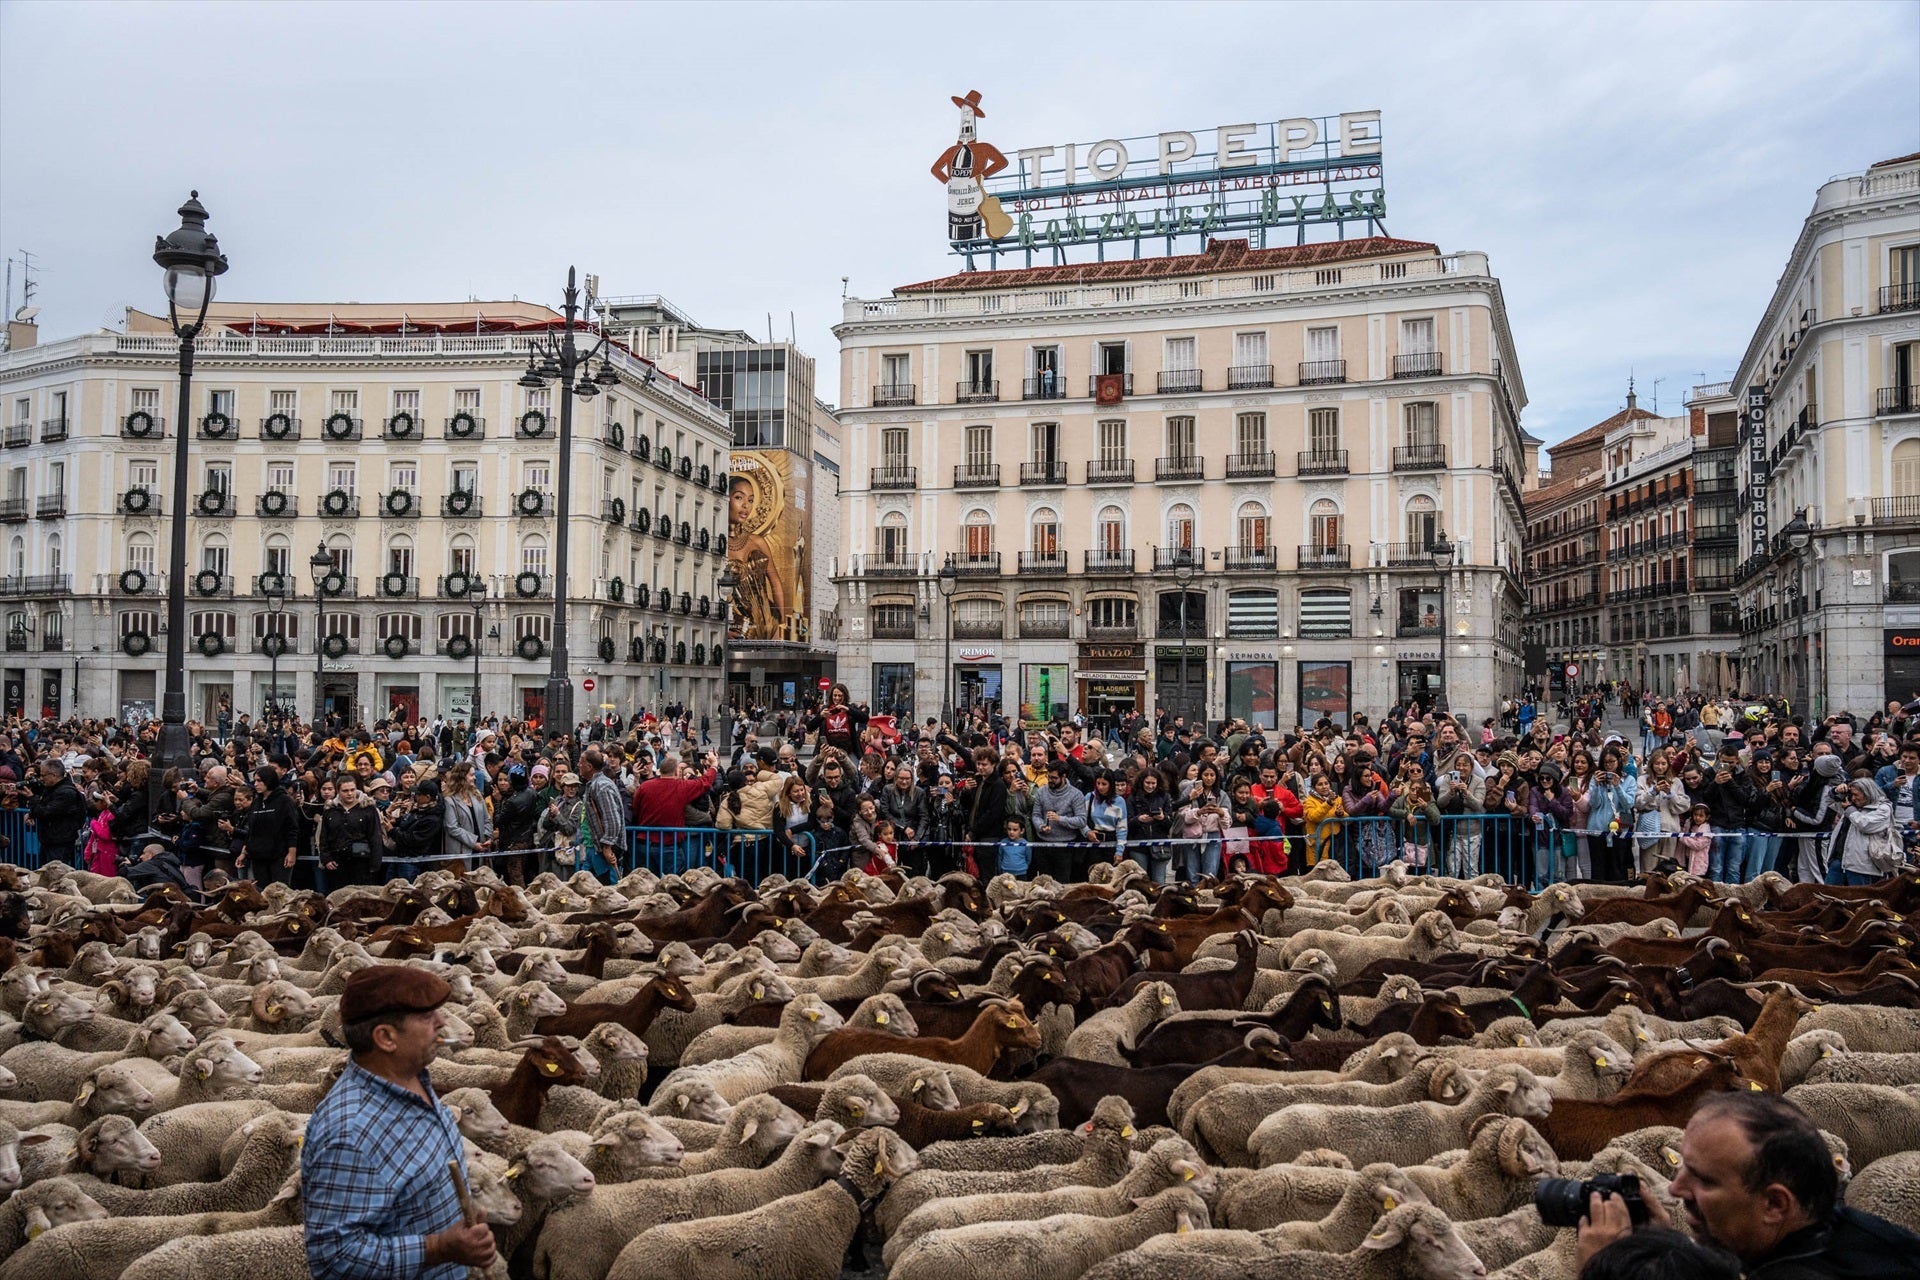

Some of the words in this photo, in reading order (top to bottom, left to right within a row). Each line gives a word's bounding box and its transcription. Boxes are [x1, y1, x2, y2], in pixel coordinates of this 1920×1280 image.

[1018, 139, 1128, 188] TIO
[1158, 109, 1382, 175] PEPE
[1014, 199, 1053, 213] SOL
[1061, 193, 1086, 208] DE
[1095, 180, 1210, 205] ANDALUCIA
[1219, 165, 1381, 192] EMBOTELLADO
[1018, 203, 1221, 246] GONZALEZ
[1261, 187, 1386, 225] BYASS
[1749, 394, 1765, 463] HOTEL
[1752, 472, 1767, 555] EUROPA
[960, 648, 995, 656] PRIMOR
[1089, 648, 1131, 657] PALAZZO
[1230, 652, 1273, 660] SEPHORA
